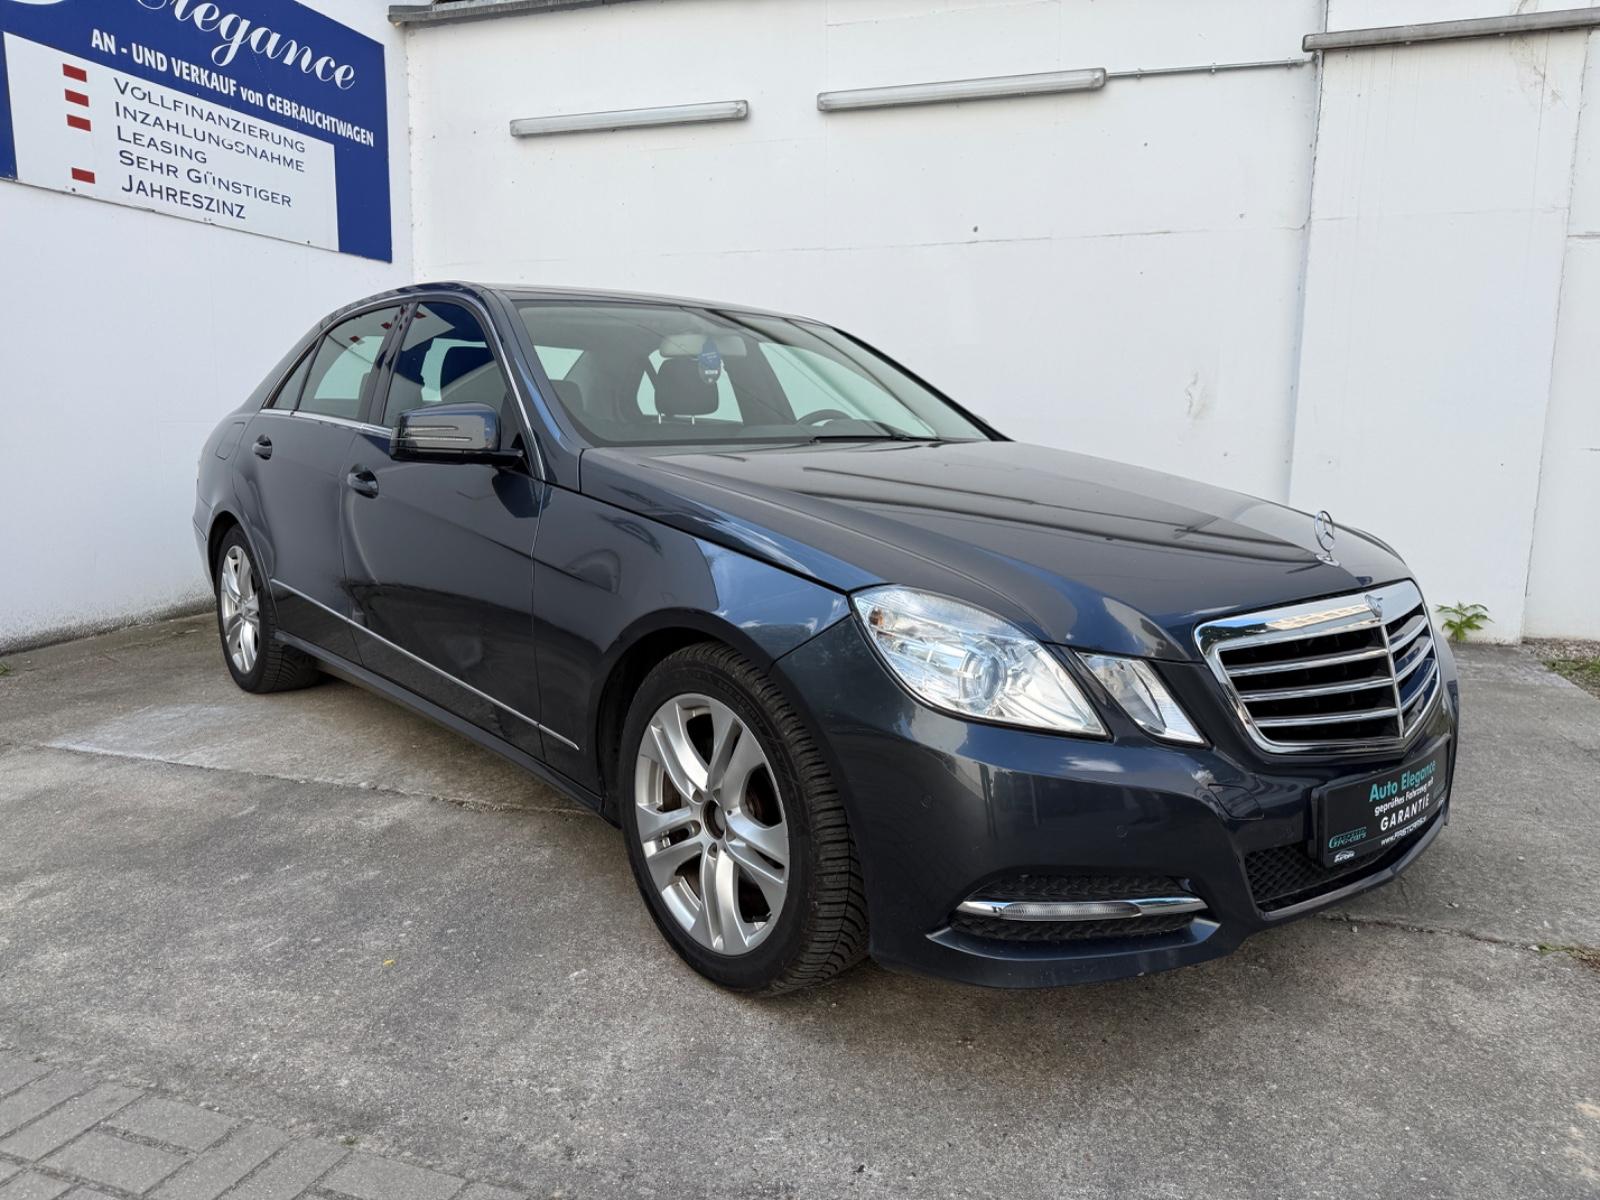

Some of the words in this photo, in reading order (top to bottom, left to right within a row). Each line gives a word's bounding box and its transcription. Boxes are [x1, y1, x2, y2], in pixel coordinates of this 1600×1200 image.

[138, 0, 356, 90] egance
[91, 28, 117, 55] AN
[131, 42, 168, 72] UND
[171, 56, 237, 97] VERKAUF
[240, 86, 264, 108] von
[267, 93, 375, 148] GEBRAUCHTWAGEN
[113, 77, 306, 154] VOLLFINANZIERUNG
[115, 101, 305, 173] INZAHLUNGSNAHME
[117, 125, 208, 164] LEASING
[119, 150, 179, 179] SEHR
[187, 163, 292, 208] GÜNSTIGER
[121, 174, 246, 220] JAHRESZINZ
[1369, 781, 1398, 802] Auto
[1401, 760, 1436, 791] Elegance
[1380, 793, 1430, 831] GARANTIE
